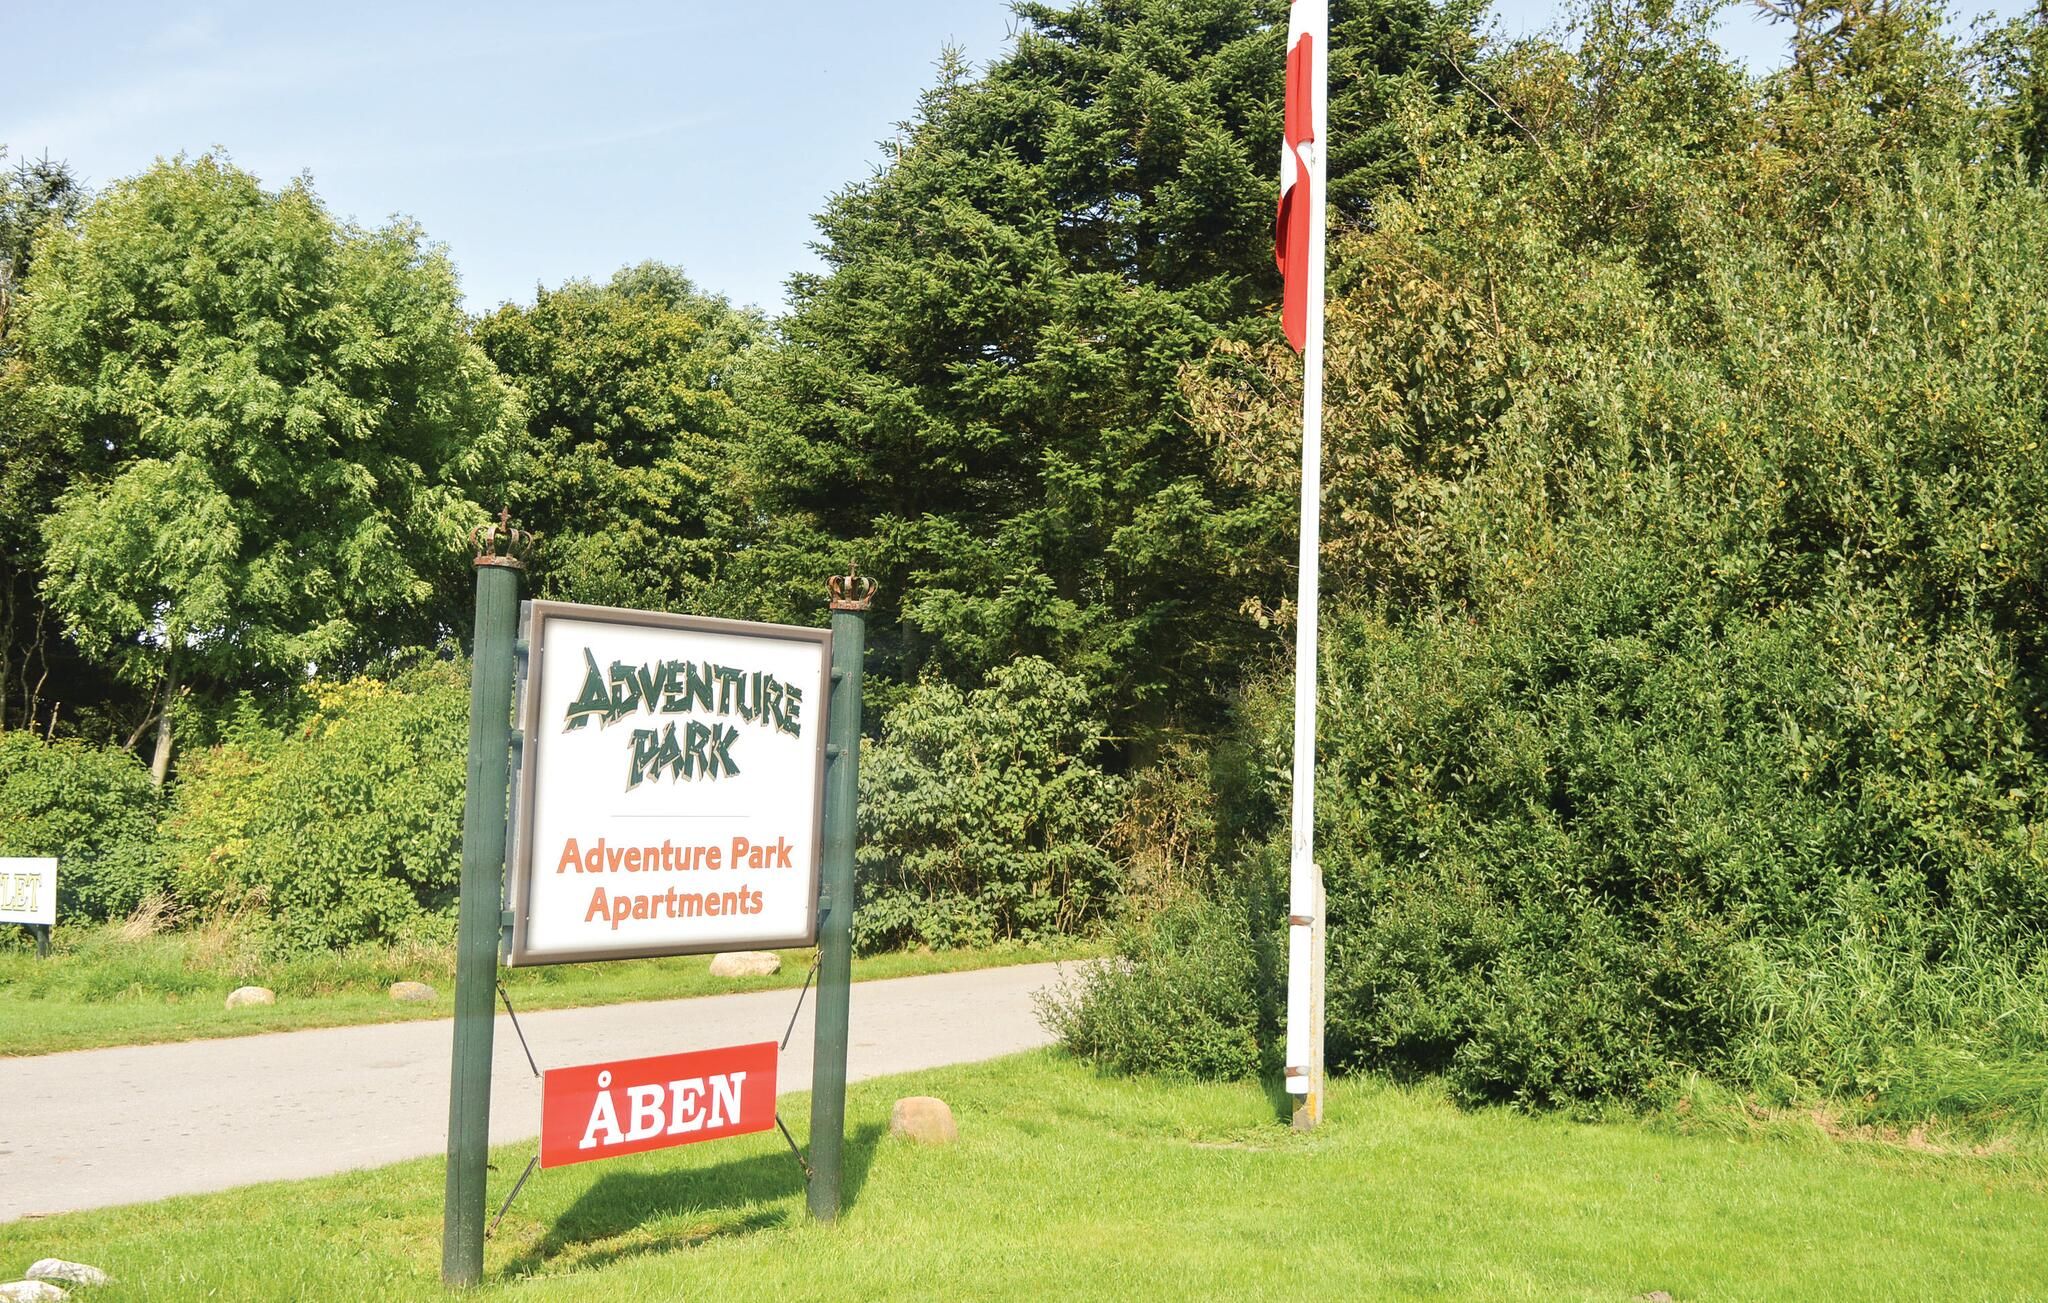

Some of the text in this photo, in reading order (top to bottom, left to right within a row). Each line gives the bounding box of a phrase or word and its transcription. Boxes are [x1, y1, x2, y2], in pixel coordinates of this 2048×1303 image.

[562, 647, 803, 739] ADVENTURE
[625, 720, 741, 793] PARK
[556, 836, 794, 874] Adventure Park
[0, 872, 42, 912] LET
[584, 884, 764, 930] Apartments
[579, 1070, 747, 1149] ÅBEN
